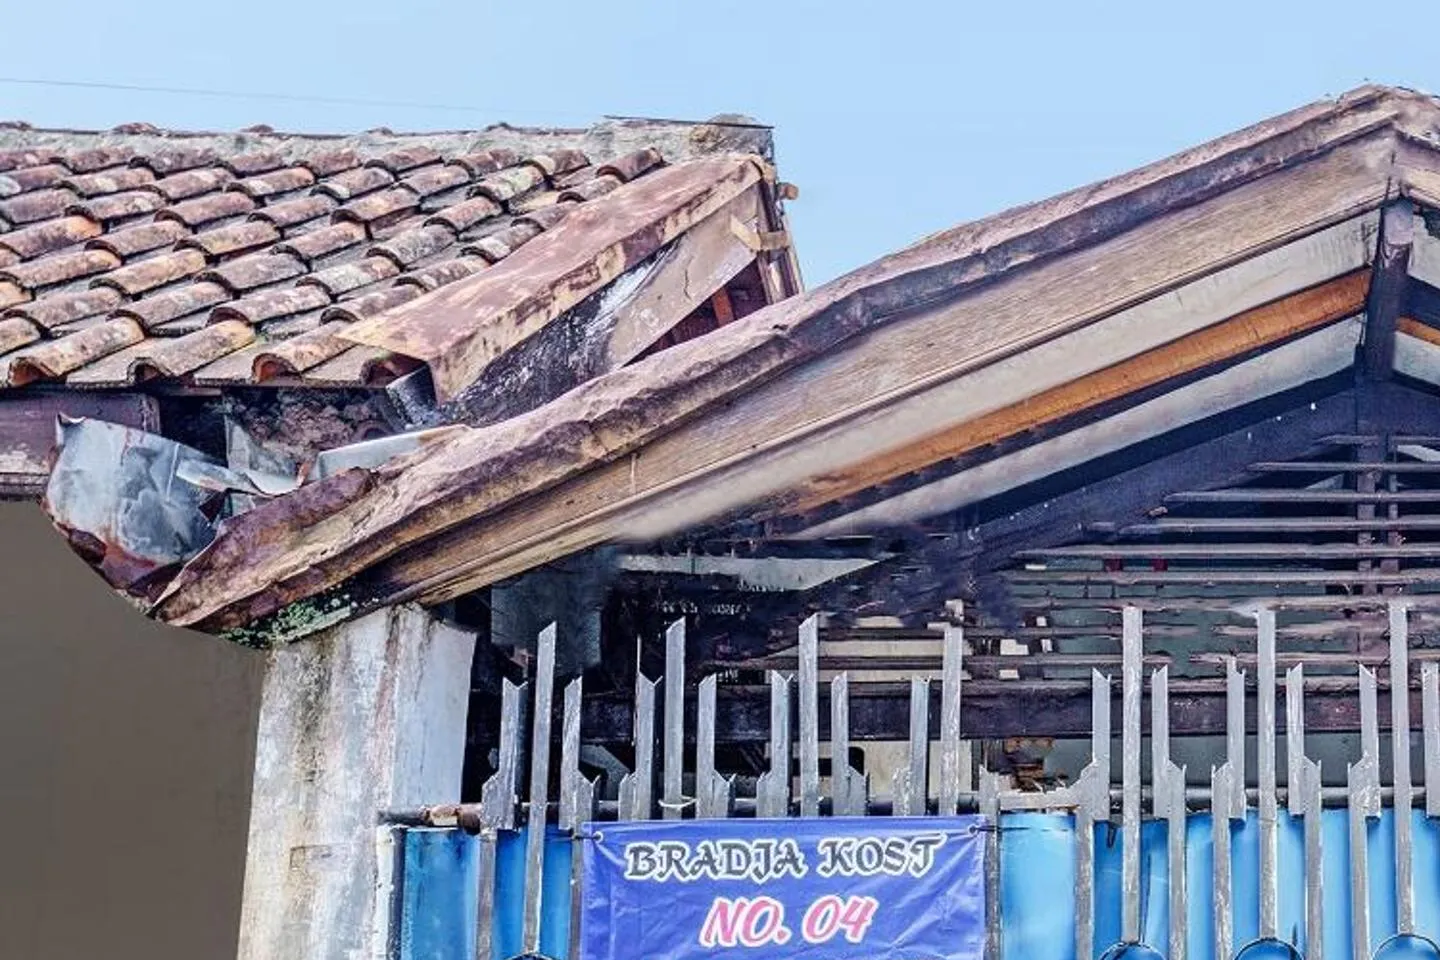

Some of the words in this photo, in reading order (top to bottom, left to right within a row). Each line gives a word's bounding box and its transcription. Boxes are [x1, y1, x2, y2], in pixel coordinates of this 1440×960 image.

[625, 838, 805, 884] BRADJA
[819, 832, 948, 877] KOST
[700, 898, 791, 947] NO.
[802, 895, 879, 943] 04
